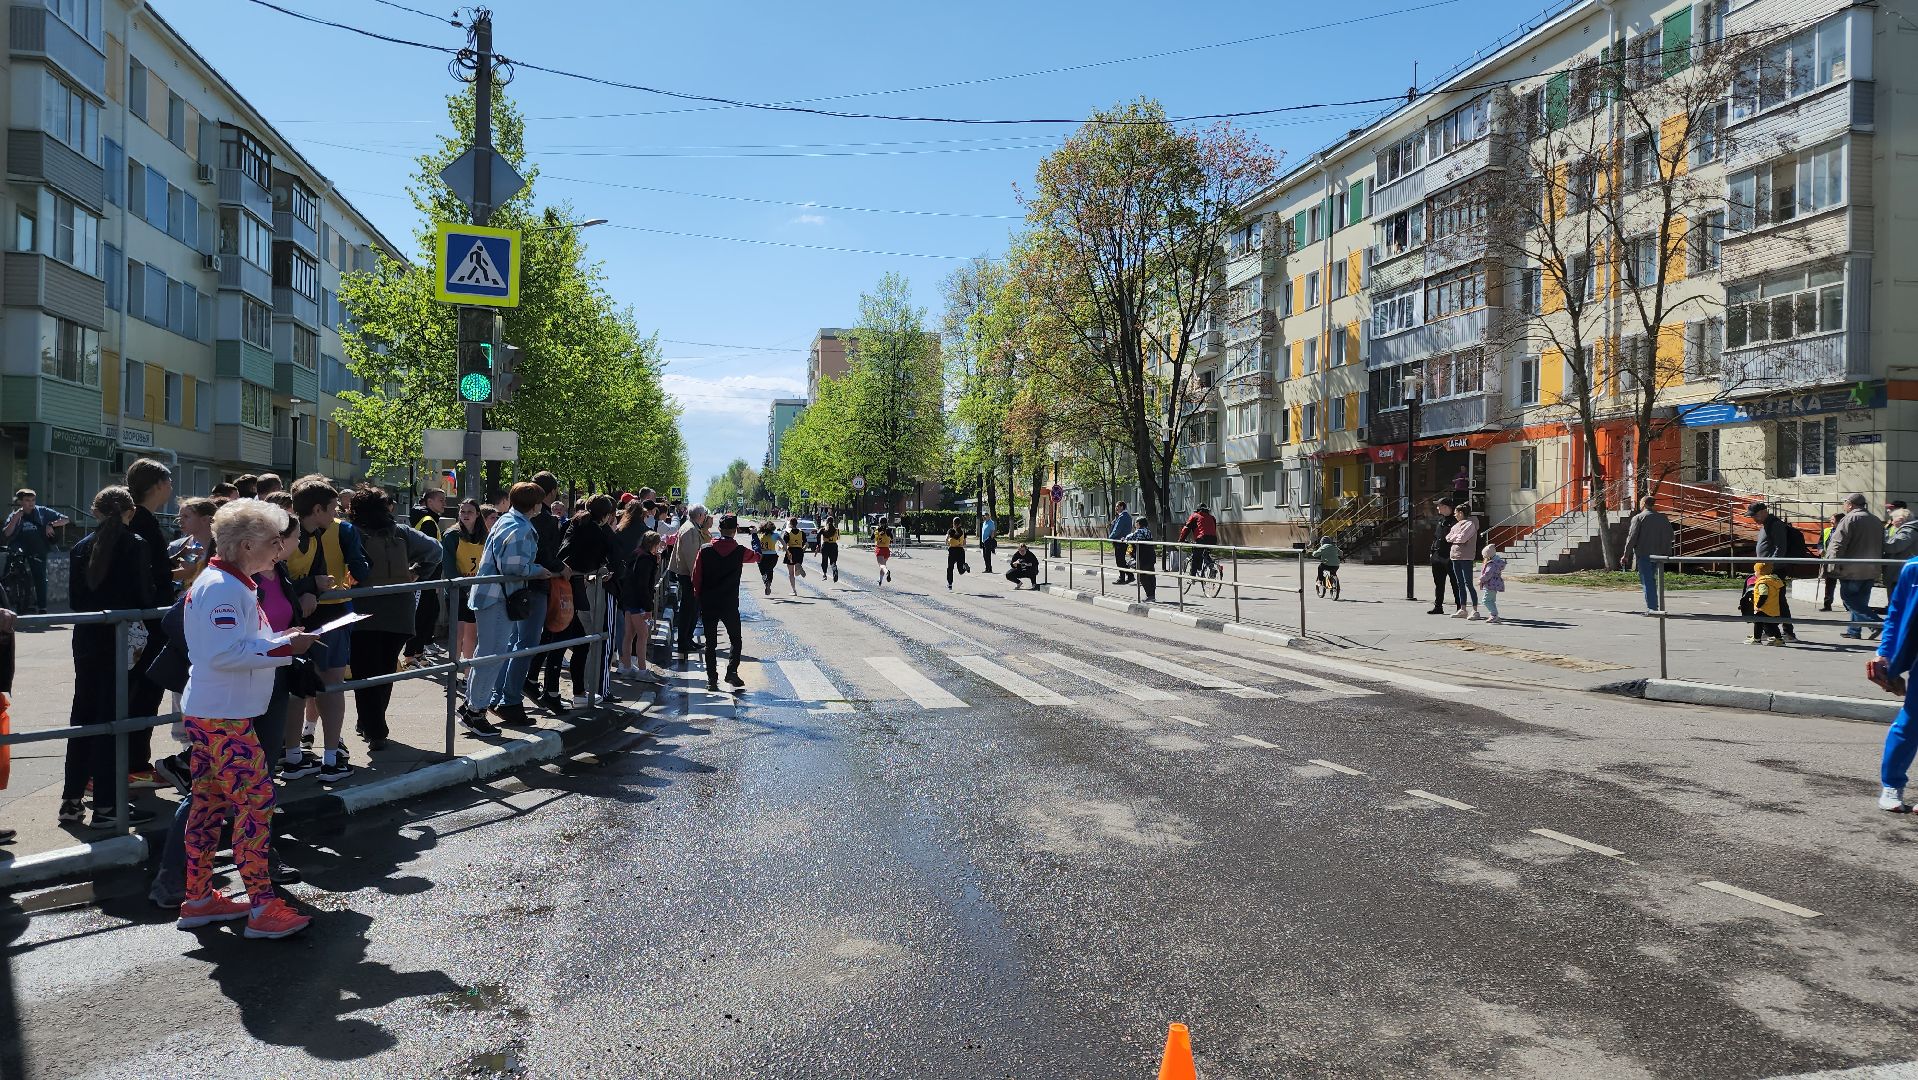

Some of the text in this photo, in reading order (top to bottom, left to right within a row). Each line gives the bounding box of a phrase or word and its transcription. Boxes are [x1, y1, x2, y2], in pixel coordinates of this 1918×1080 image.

[1446, 438, 1467, 448] ТАБАК
[69, 445, 89, 455] САЛОН
[470, 557, 477, 572] 3
